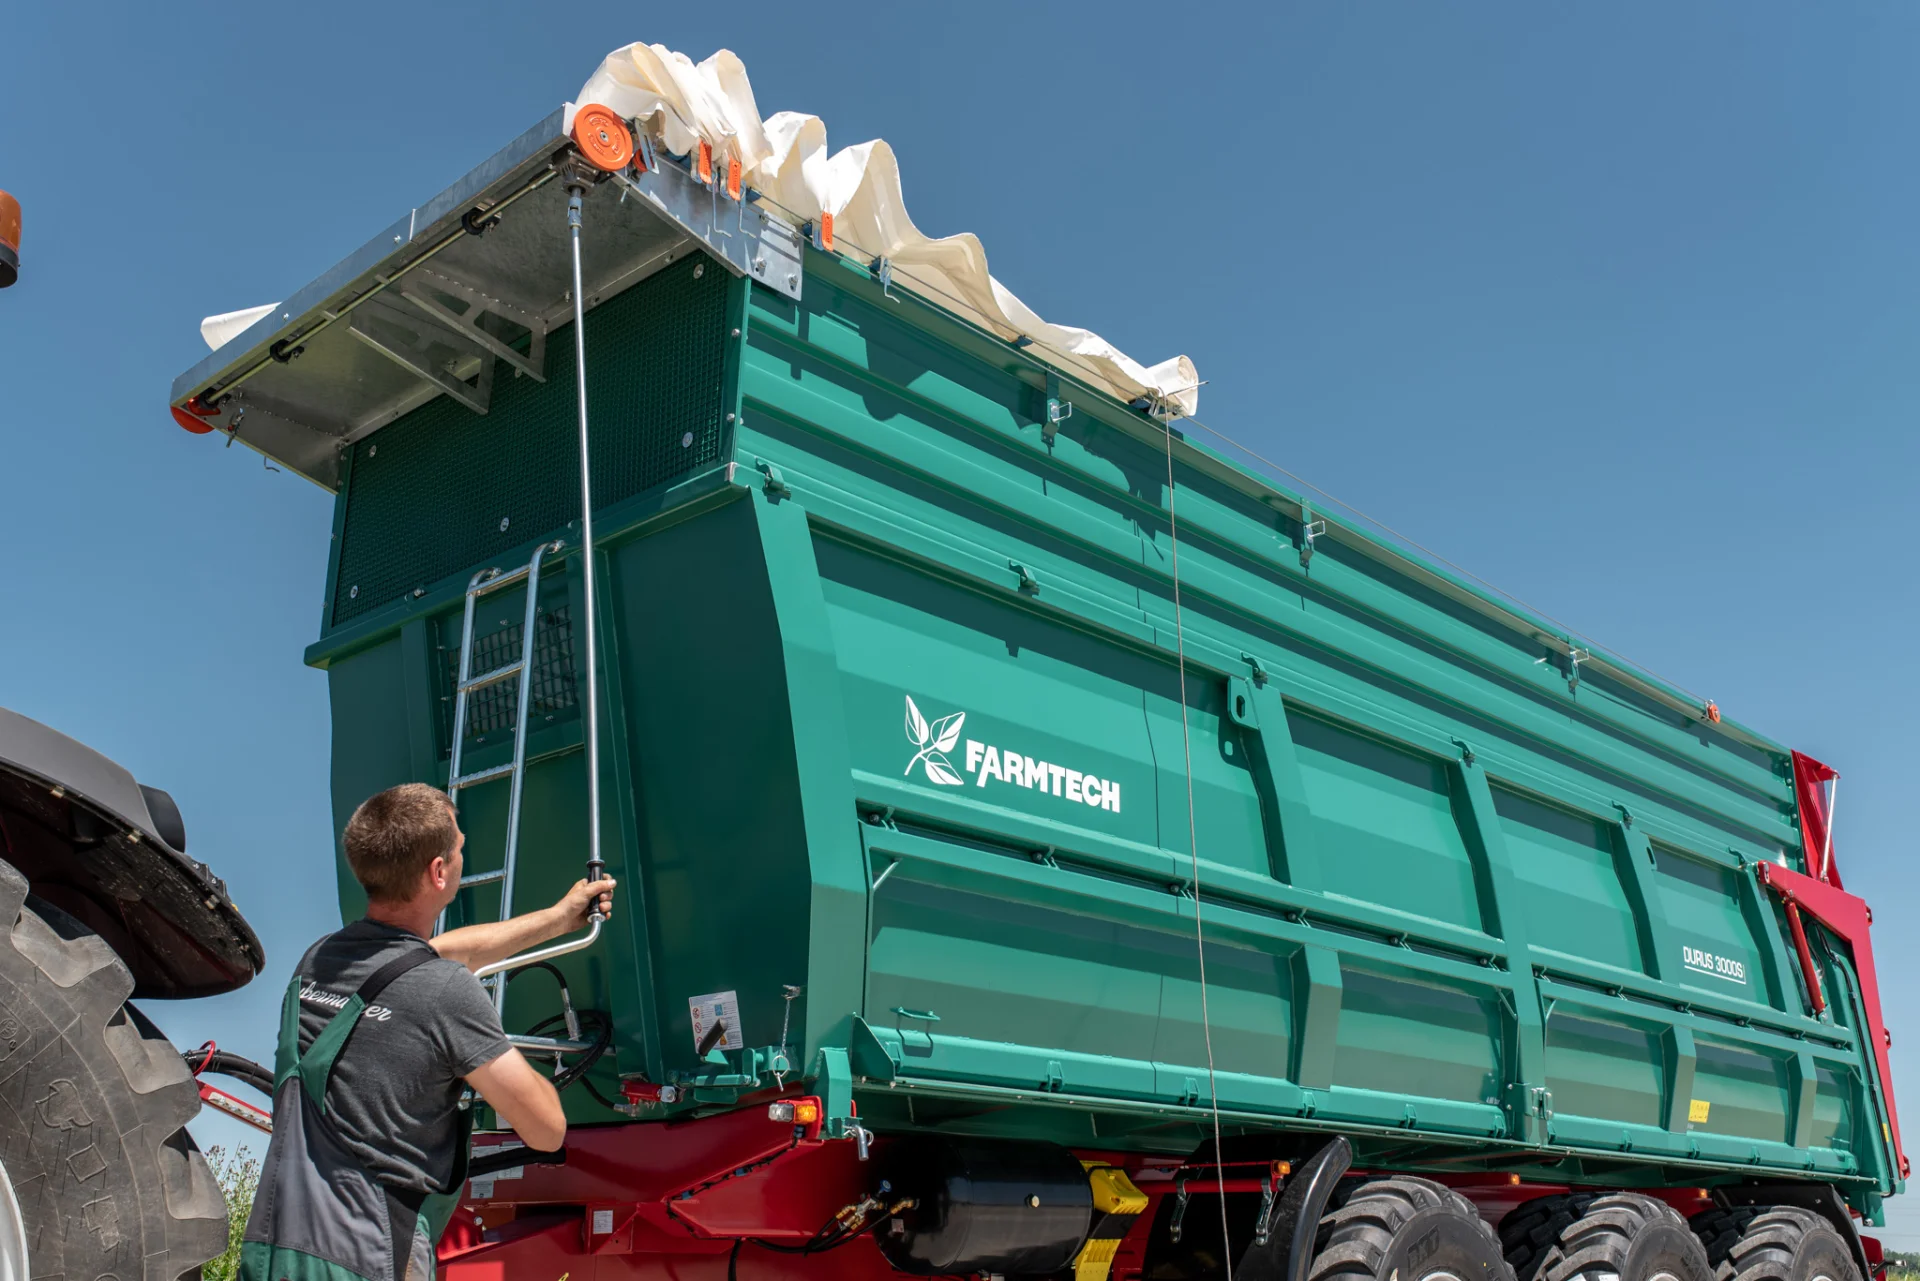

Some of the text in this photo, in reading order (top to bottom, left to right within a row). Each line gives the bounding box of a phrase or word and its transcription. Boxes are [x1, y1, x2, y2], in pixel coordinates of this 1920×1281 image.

[966, 739, 1120, 813] FARMTECH
[1683, 946, 1743, 978] DURUS 3000S
